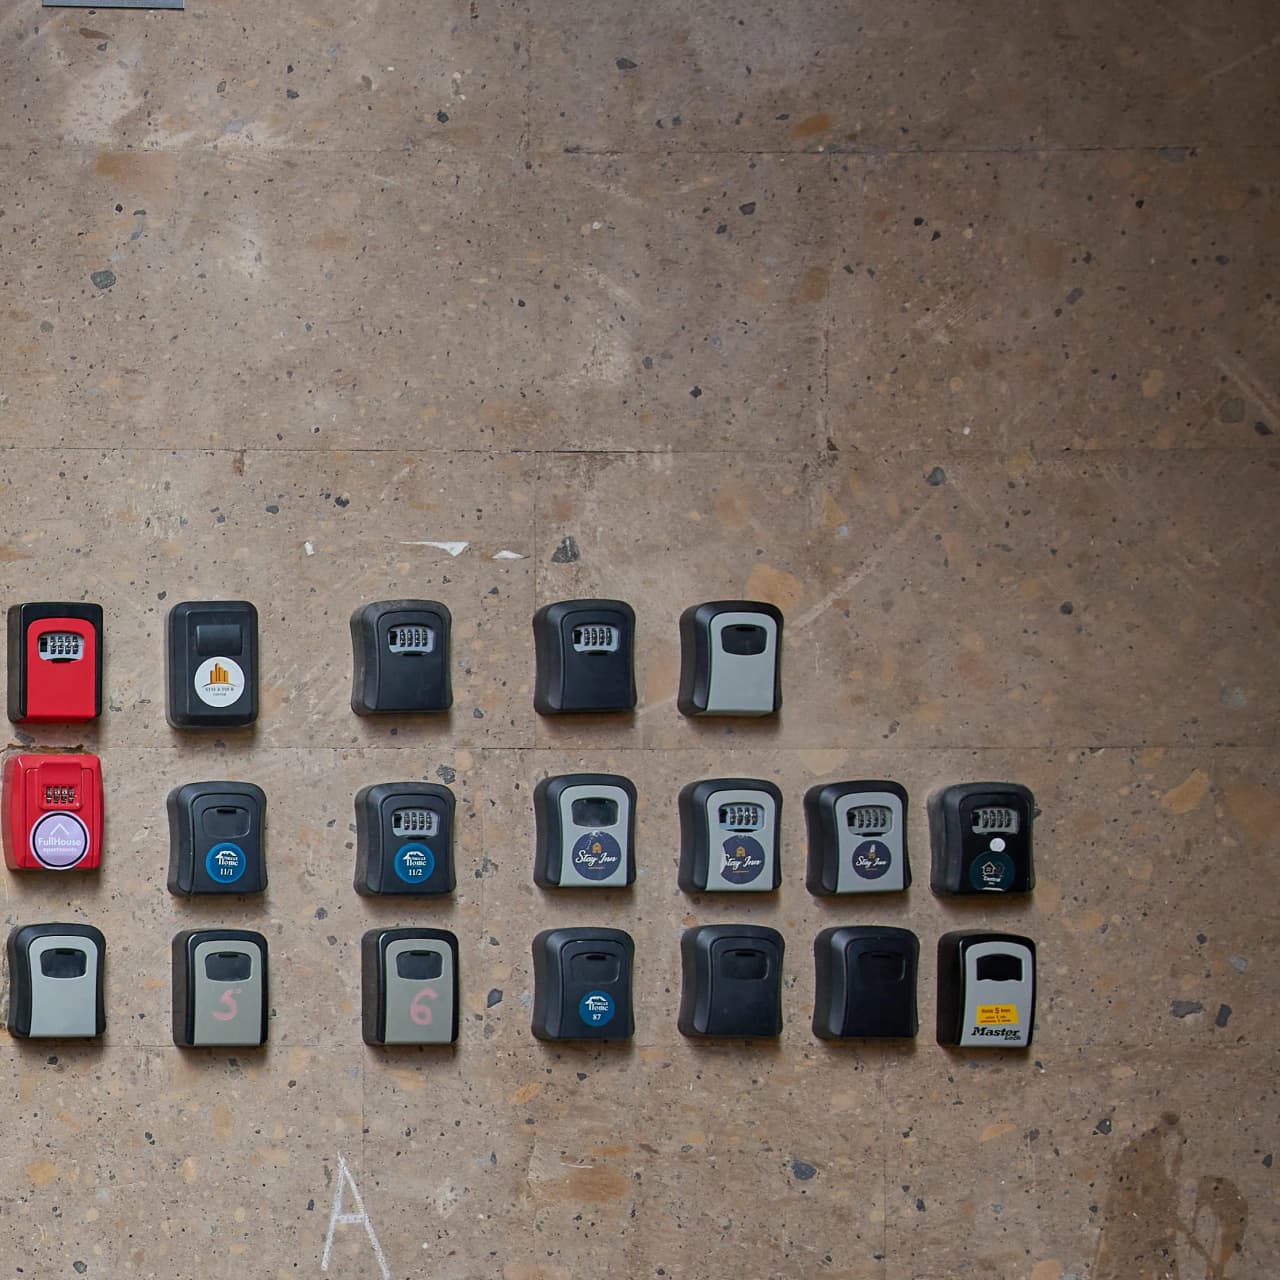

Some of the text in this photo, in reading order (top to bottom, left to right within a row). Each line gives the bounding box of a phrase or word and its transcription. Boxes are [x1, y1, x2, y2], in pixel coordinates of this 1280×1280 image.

[38, 837, 81, 846] FullHouse
[575, 849, 618, 867] Stay Inn
[742, 855, 762, 868] Inn
[855, 855, 872, 869] Stay
[408, 868, 423, 876] 11/2
[212, 988, 242, 1021] 5
[409, 987, 439, 1026] 6
[971, 1026, 1021, 1036] Master
[320, 1151, 391, 1280] A
